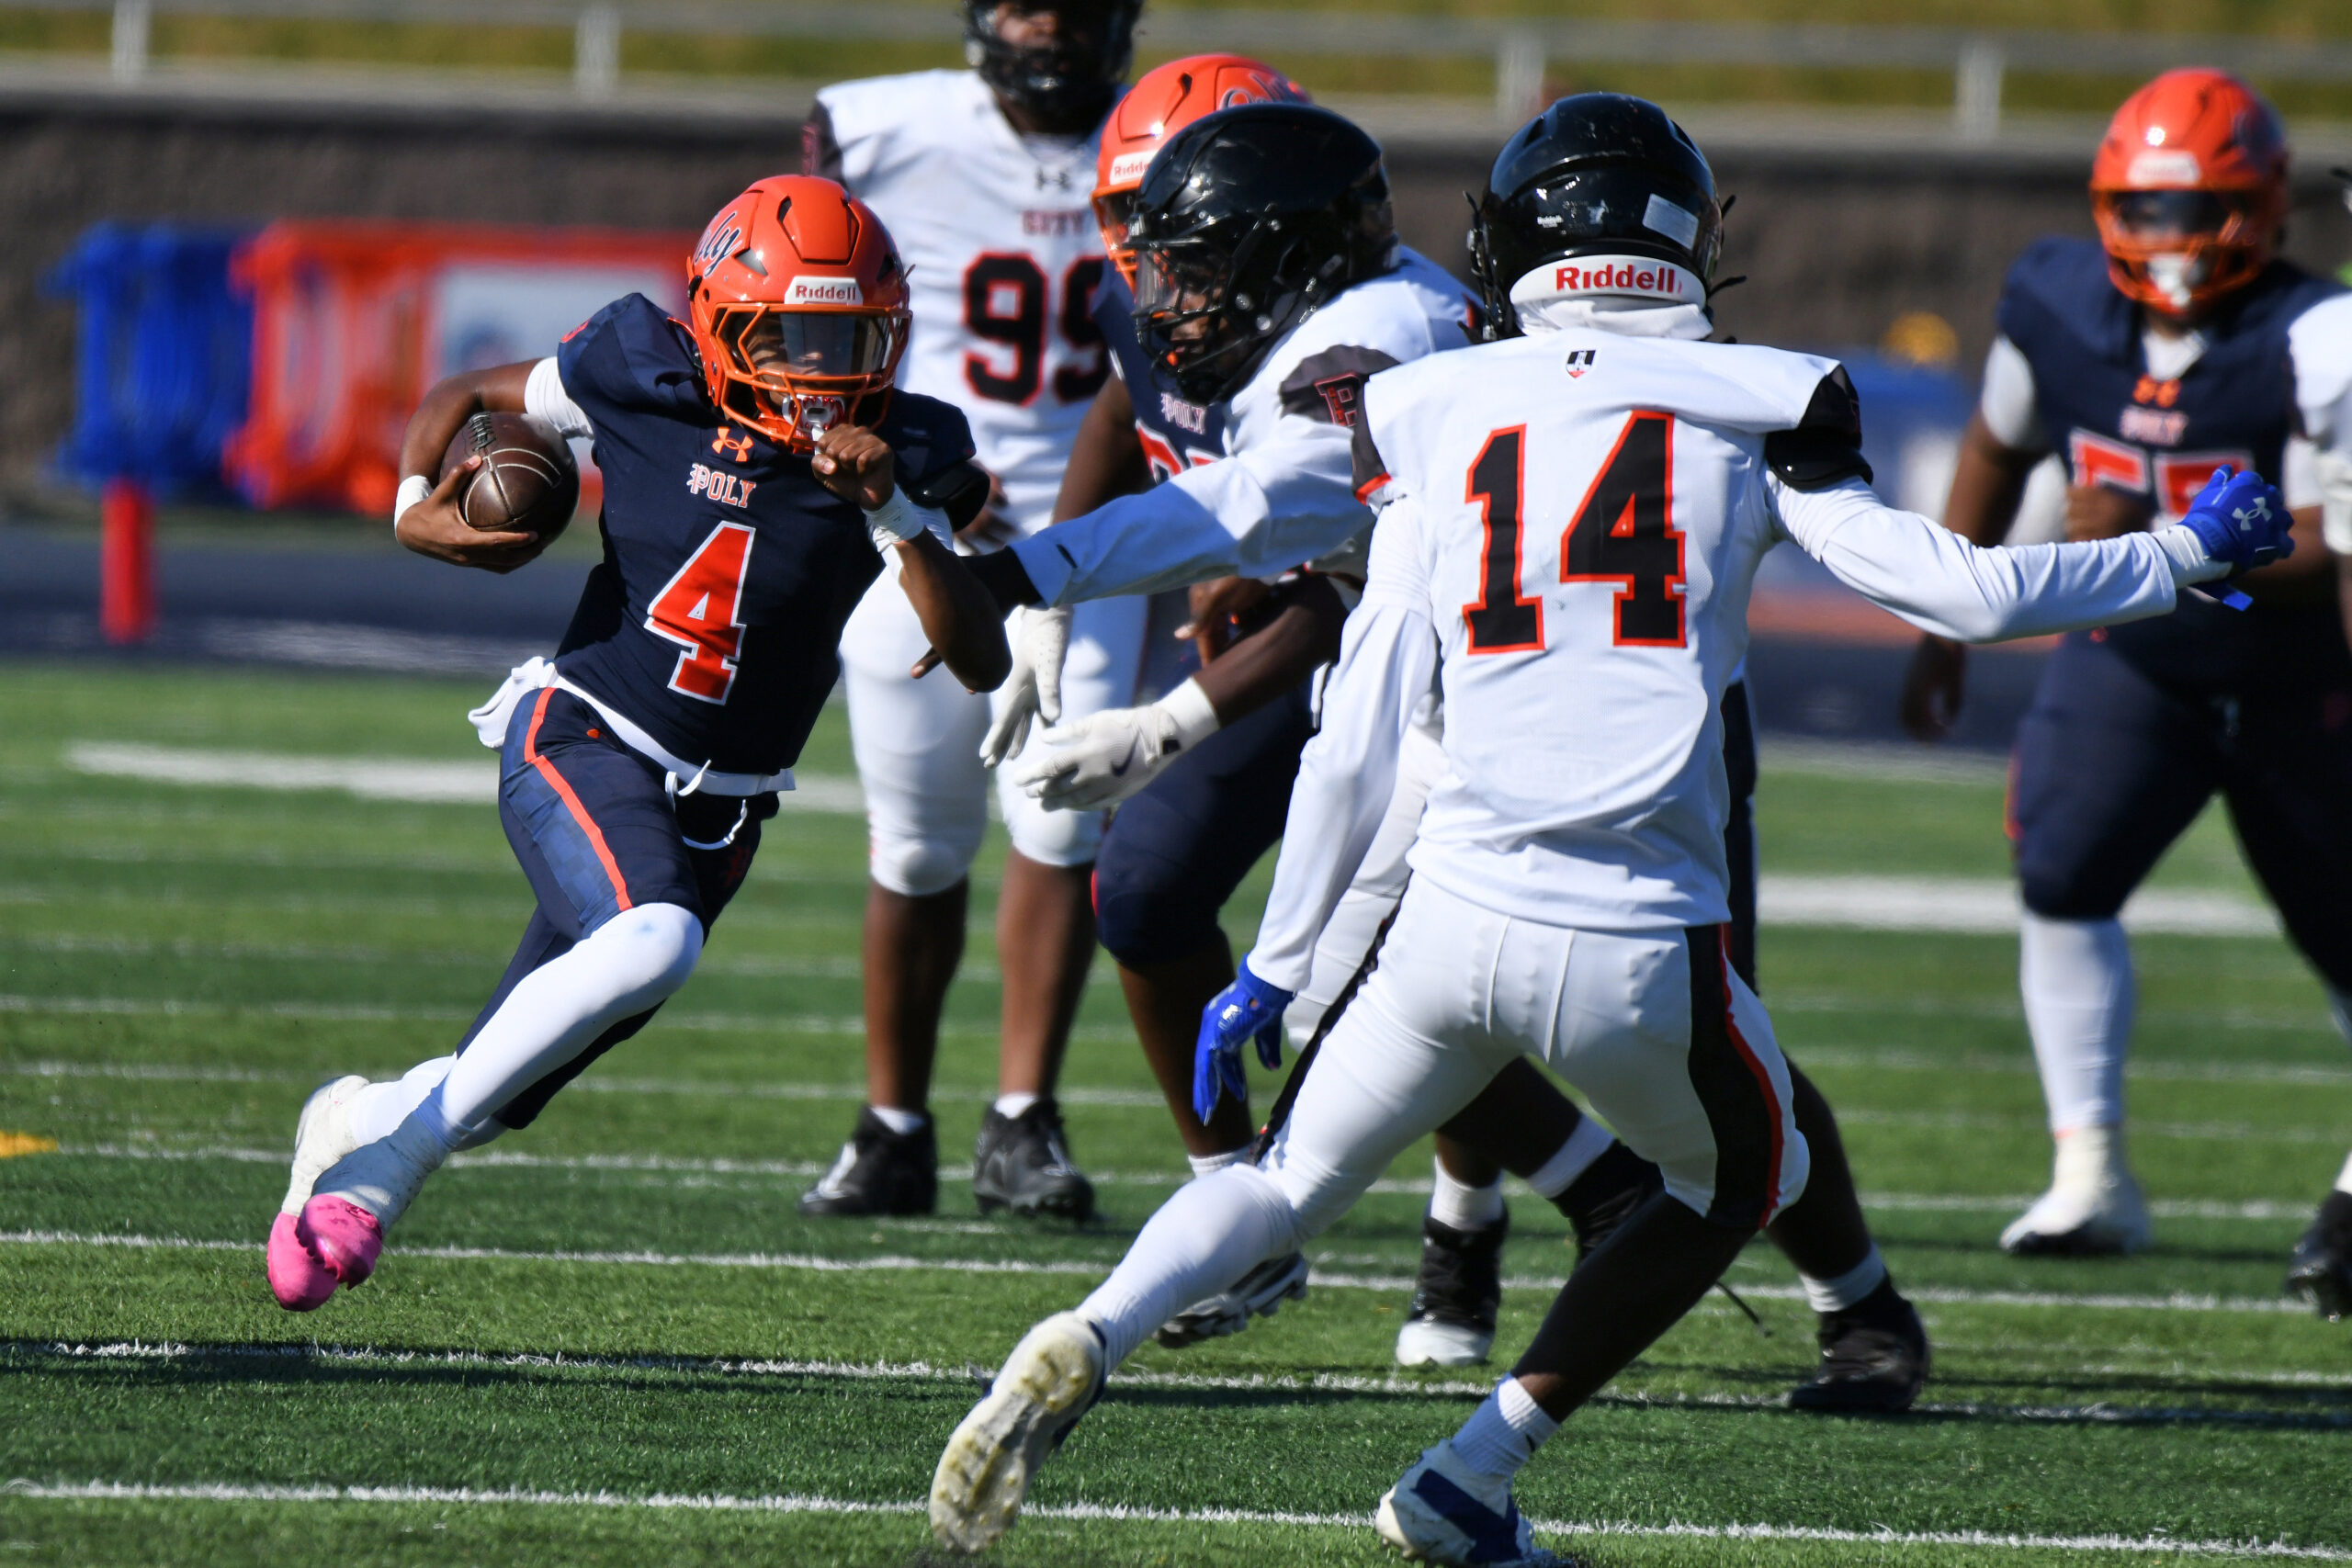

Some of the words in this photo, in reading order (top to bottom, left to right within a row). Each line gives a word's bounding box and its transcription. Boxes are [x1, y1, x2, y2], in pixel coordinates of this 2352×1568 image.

[796, 285, 856, 300] Riddell
[1555, 265, 1675, 293] Riddell
[1160, 392, 1205, 434] POLY
[687, 463, 756, 508] POLY
[1463, 410, 1687, 655] 14
[643, 520, 756, 705] 4
